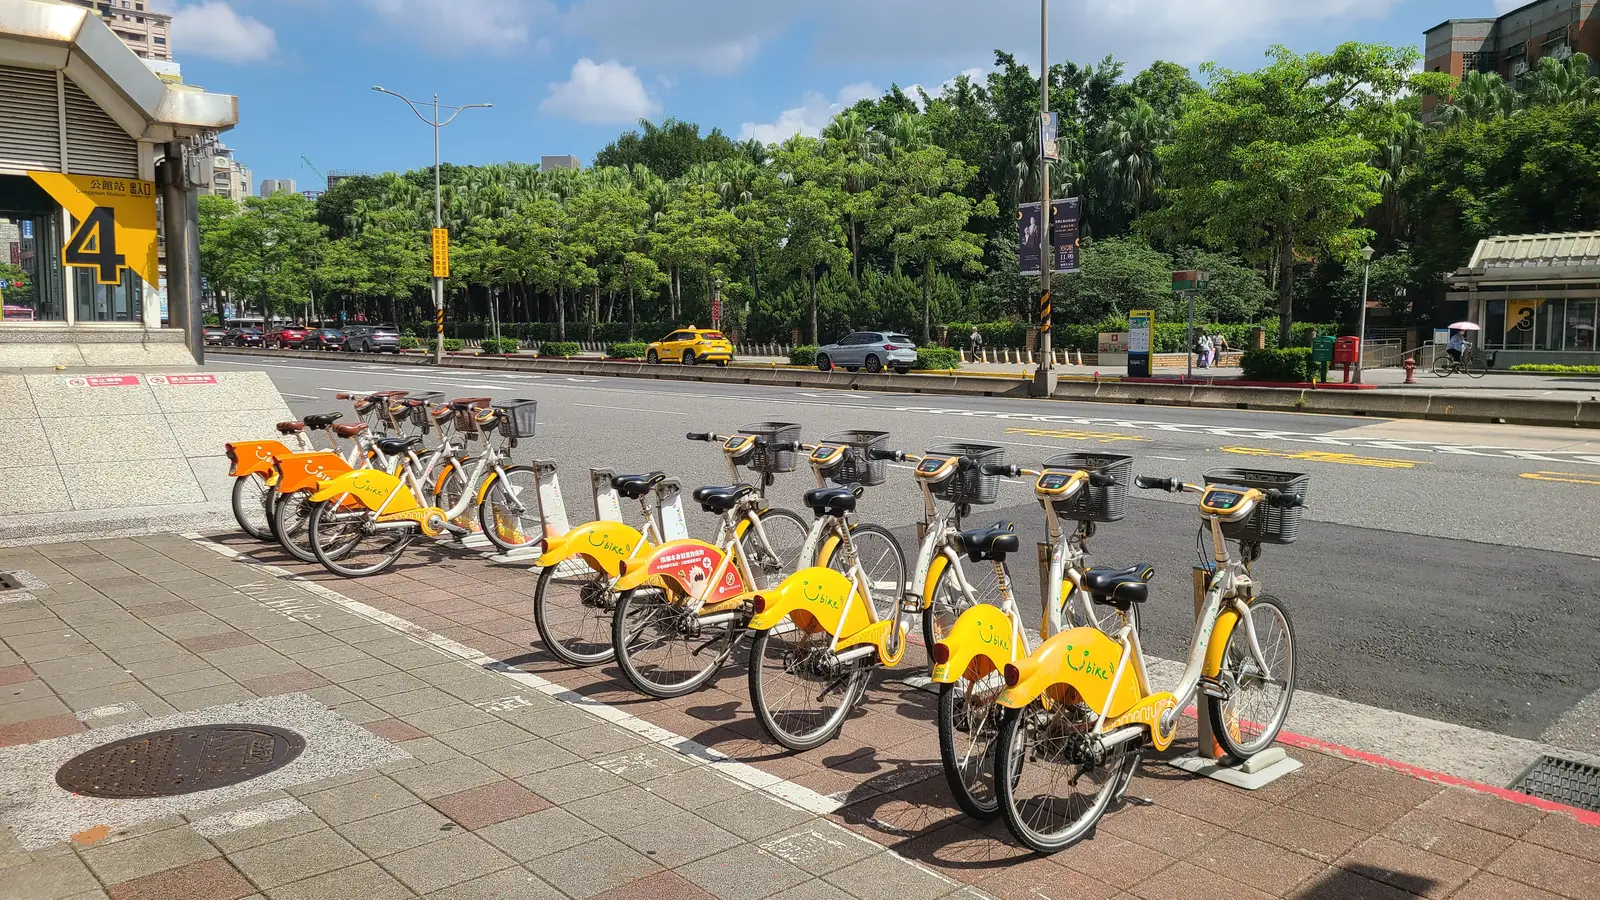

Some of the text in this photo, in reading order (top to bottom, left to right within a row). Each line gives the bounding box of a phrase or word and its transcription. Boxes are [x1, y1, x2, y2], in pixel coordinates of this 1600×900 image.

[90, 179, 151, 196] 公館站 出入口
[65, 206, 125, 282] 4
[1516, 307, 1535, 331] 3
